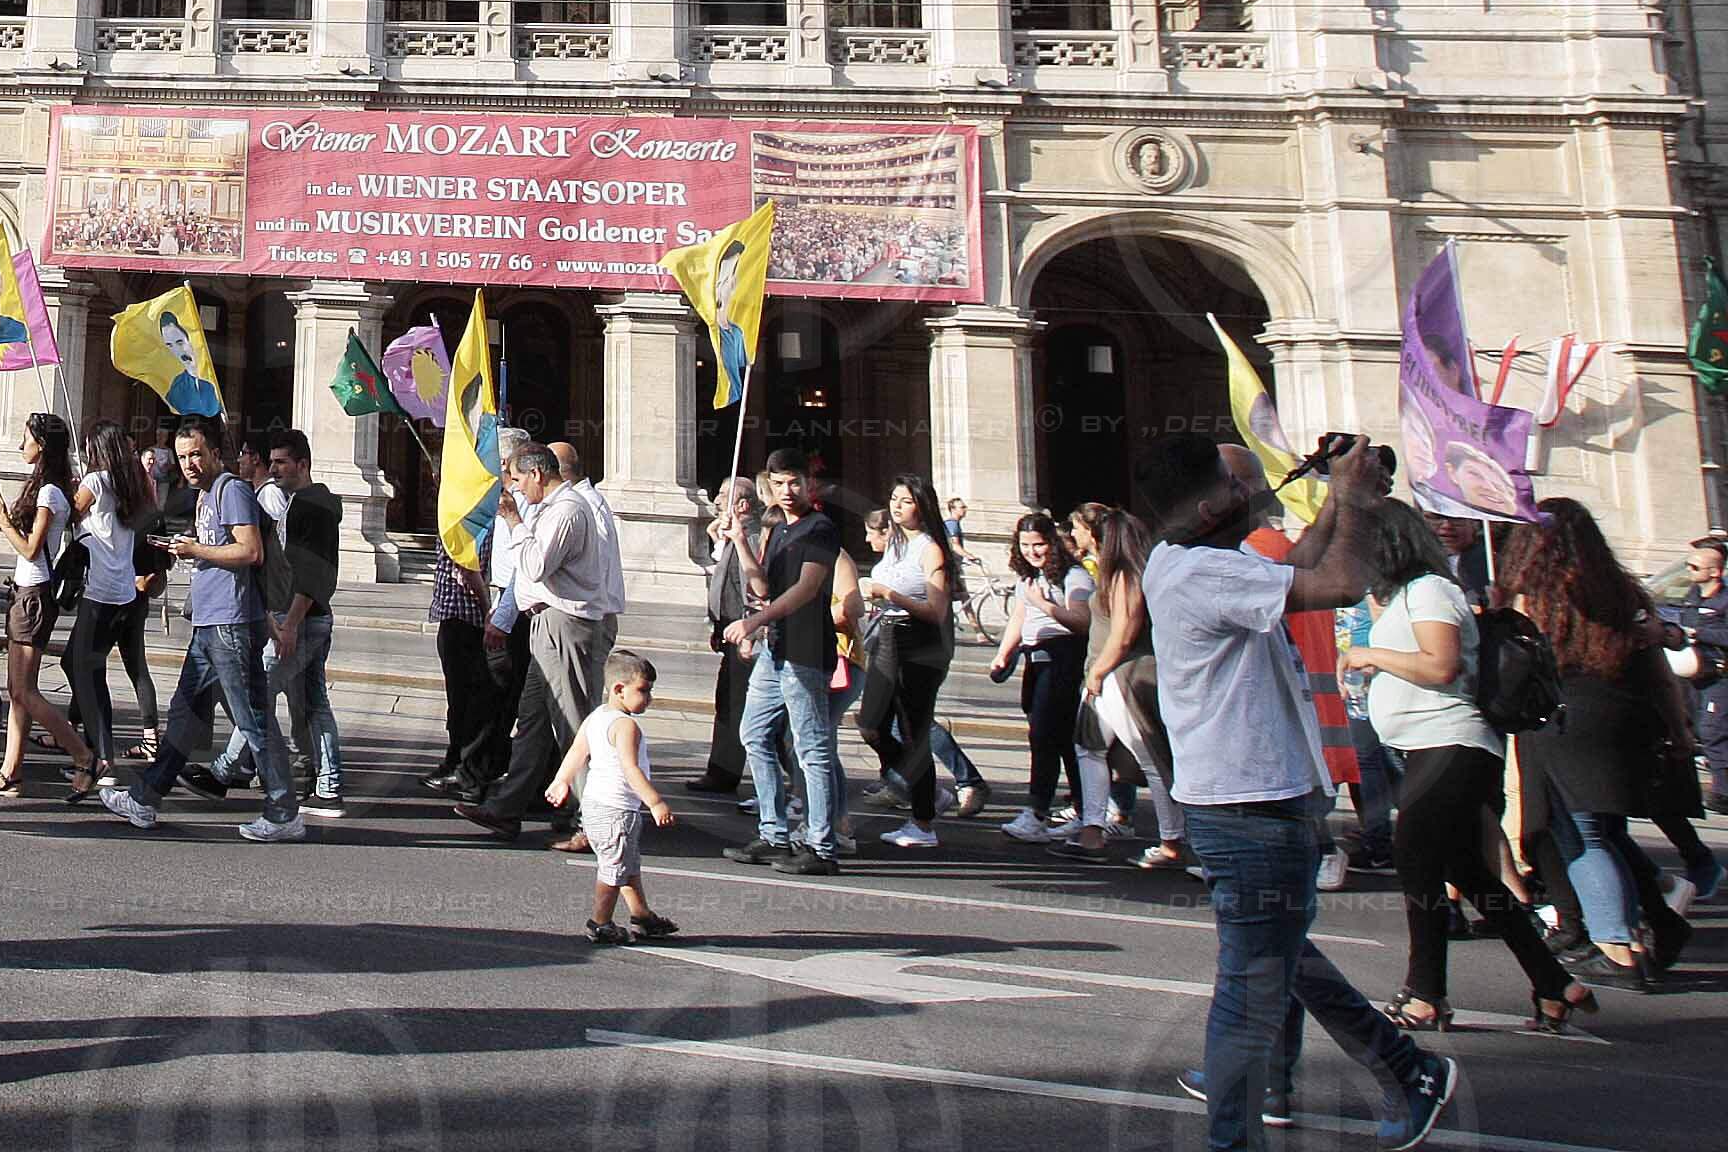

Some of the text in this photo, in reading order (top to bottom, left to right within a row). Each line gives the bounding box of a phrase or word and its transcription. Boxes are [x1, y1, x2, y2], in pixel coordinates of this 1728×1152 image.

[261, 121, 737, 162] Wiener MOZART Konzerte
[306, 174, 687, 206] in der WIENER STAATSOPER
[255, 217, 285, 232] und
[290, 218, 310, 232] im
[316, 211, 526, 239] MUSIKVEREIN
[538, 217, 667, 244] Goldener
[268, 246, 338, 263] Tickets:
[375, 250, 412, 266] +43
[420, 252, 429, 267] 1
[437, 252, 471, 269] 505
[478, 253, 503, 270] 77
[508, 255, 533, 271] 66
